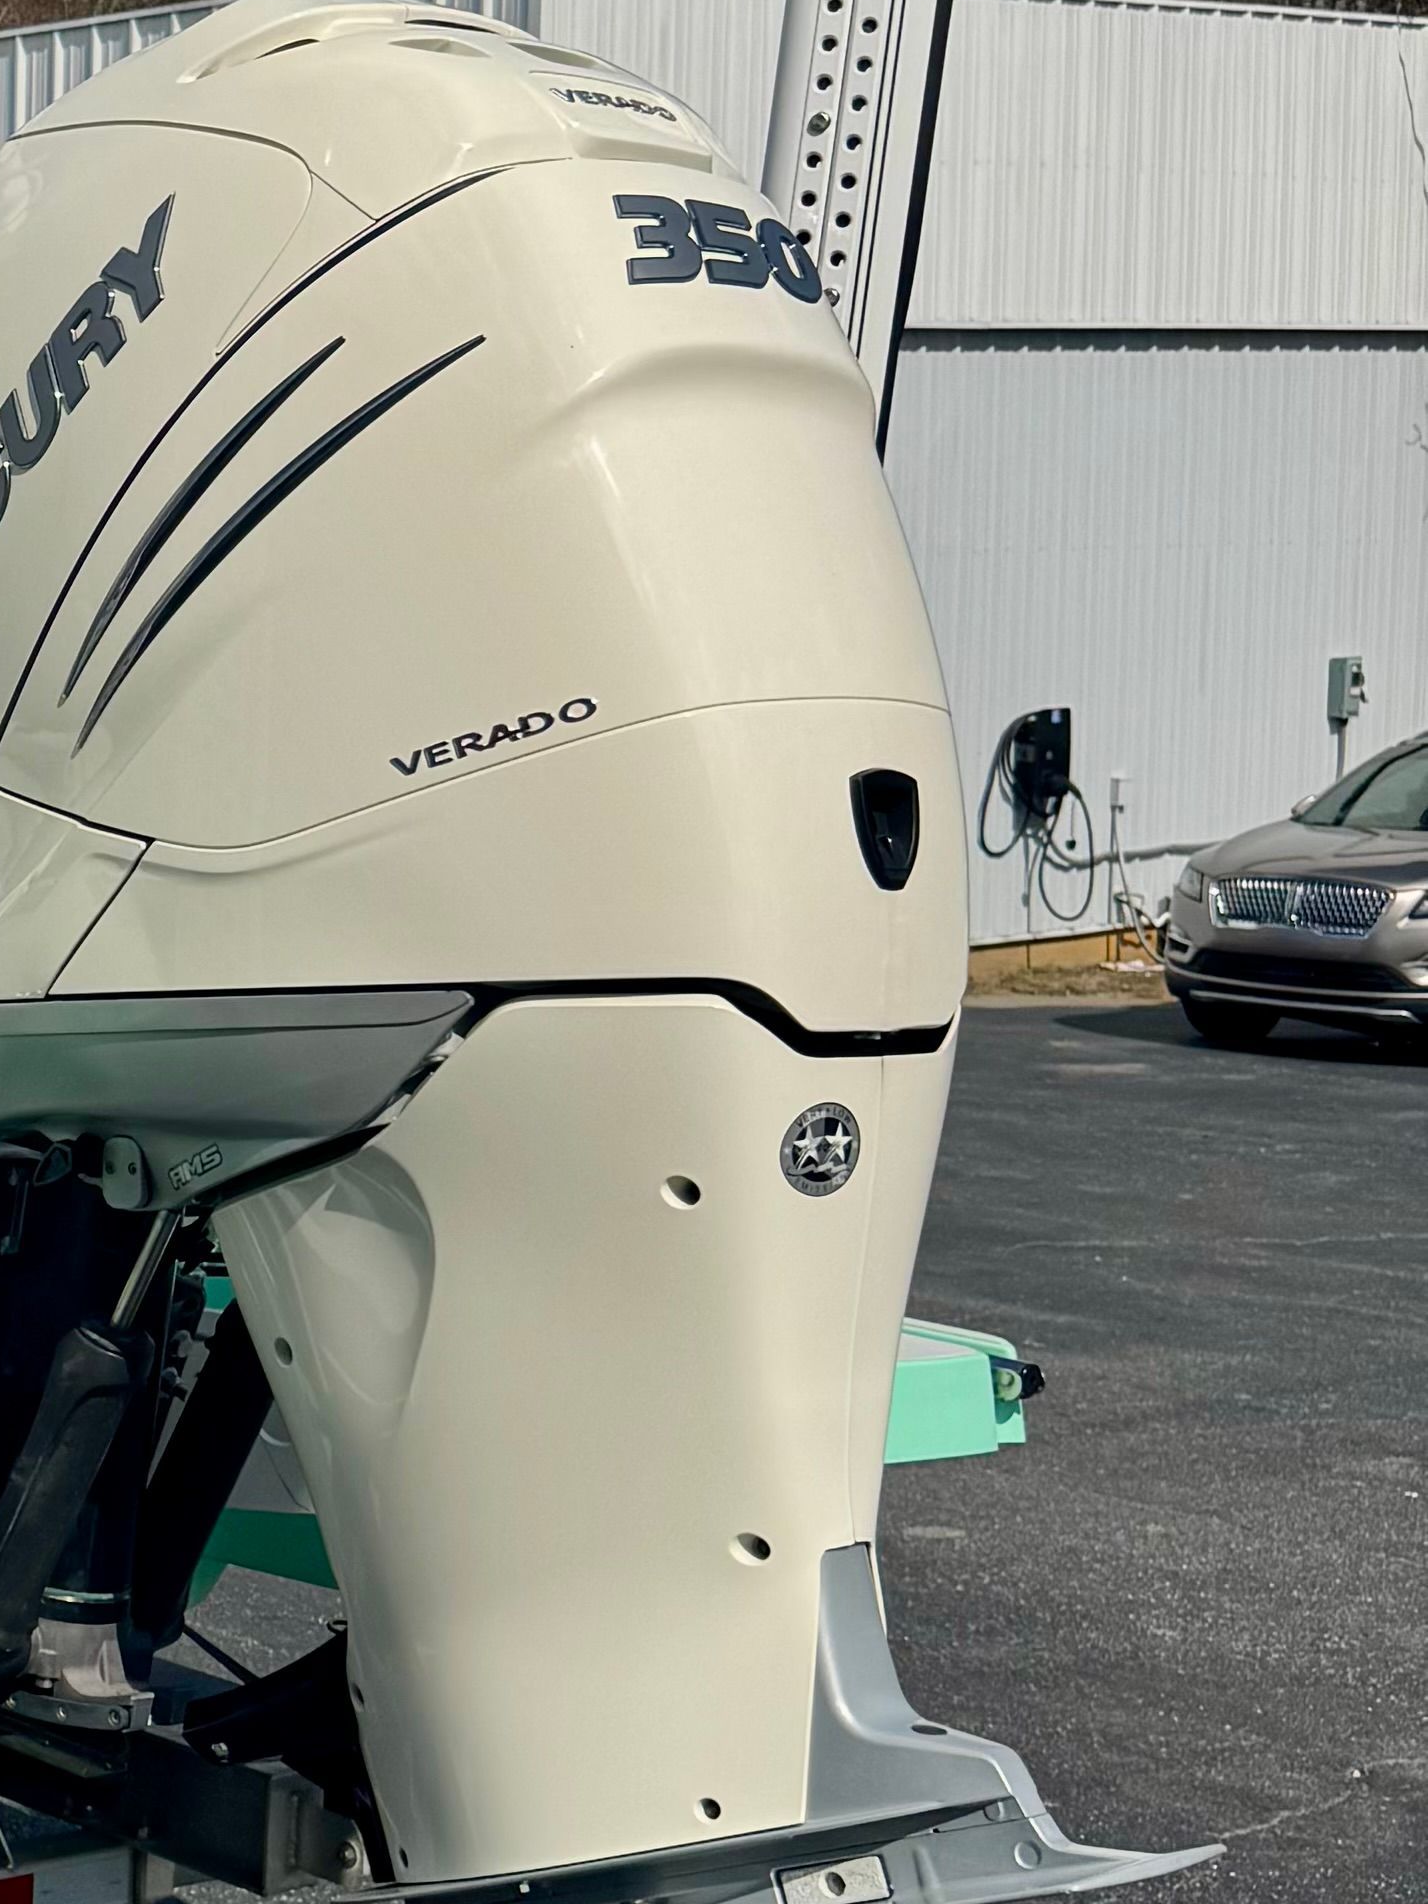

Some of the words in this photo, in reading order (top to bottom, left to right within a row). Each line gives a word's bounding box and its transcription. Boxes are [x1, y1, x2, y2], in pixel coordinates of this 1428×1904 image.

[551, 87, 676, 121] VERADO
[613, 193, 823, 304] 350
[390, 697, 598, 777] VERADO
[168, 1143, 223, 1190] AMS
